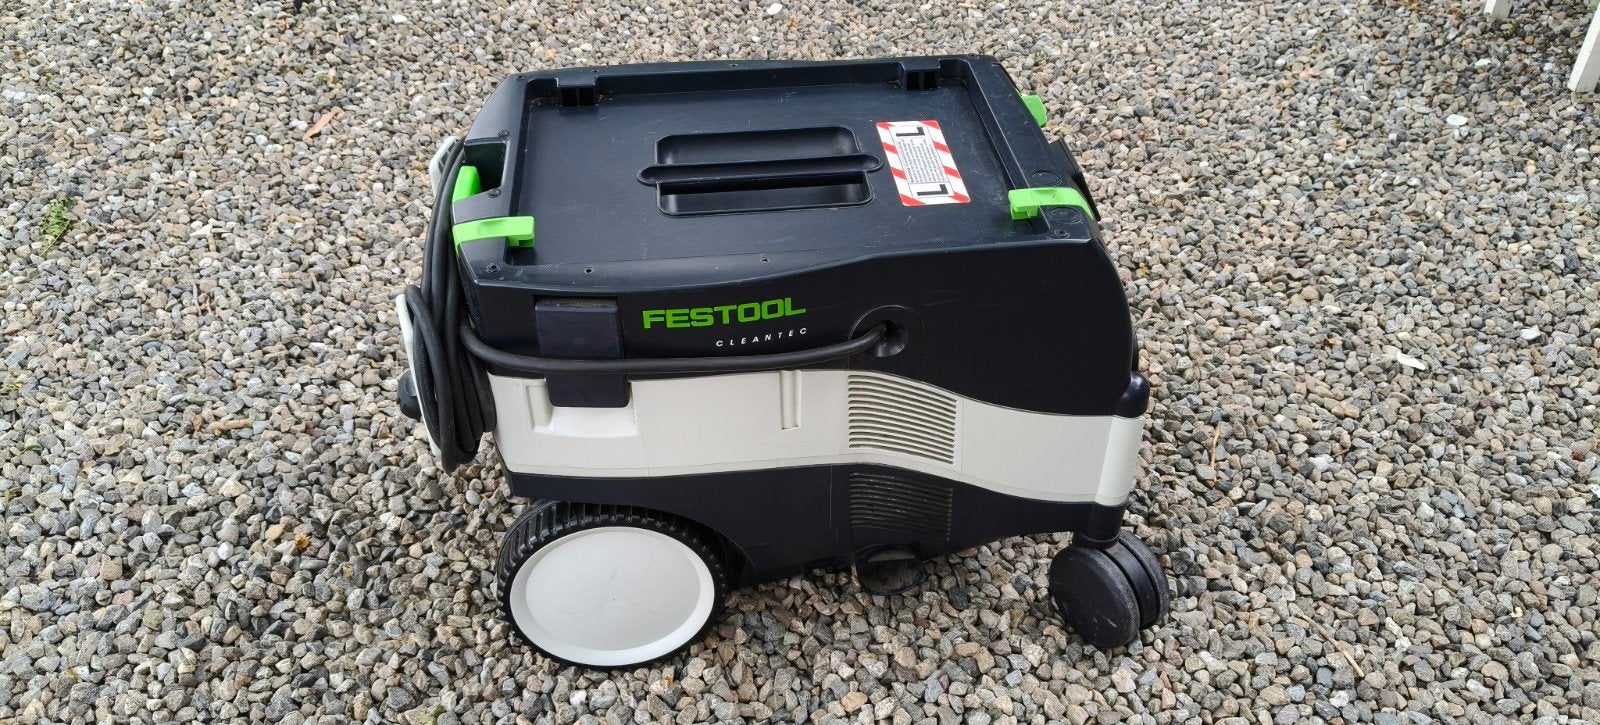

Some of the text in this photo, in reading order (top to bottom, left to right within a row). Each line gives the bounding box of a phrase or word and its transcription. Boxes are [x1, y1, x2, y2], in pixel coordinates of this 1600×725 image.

[896, 126, 925, 137] L
[917, 184, 949, 196] L
[643, 297, 806, 329] FESTOOL
[716, 328, 807, 347] CLEANTEC
